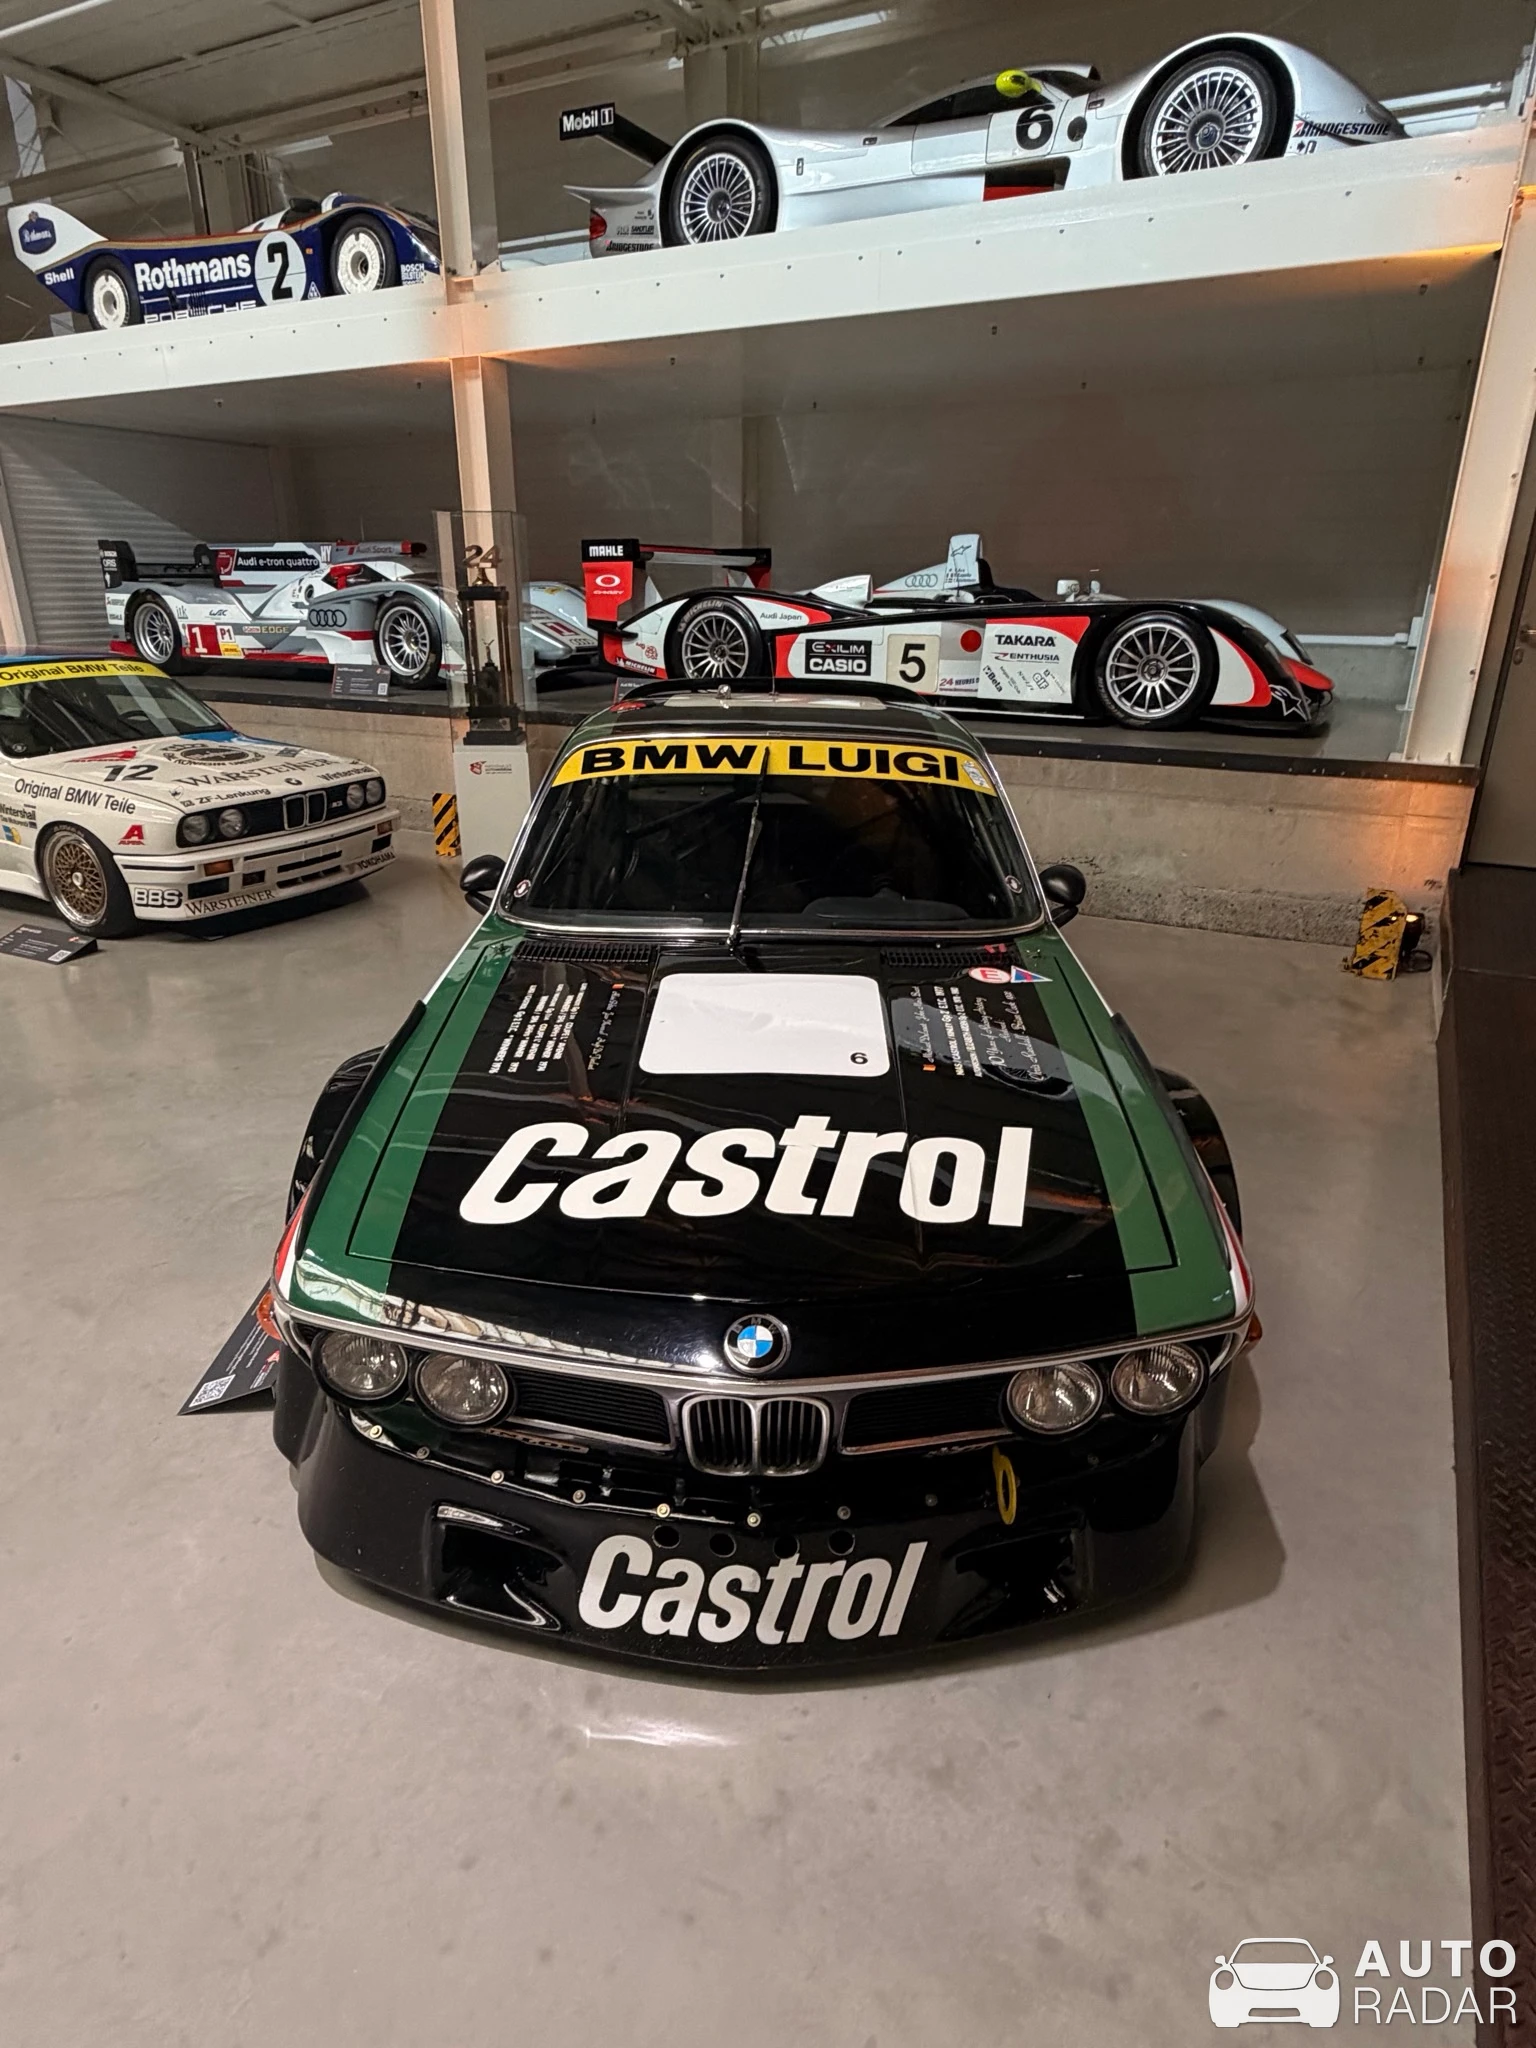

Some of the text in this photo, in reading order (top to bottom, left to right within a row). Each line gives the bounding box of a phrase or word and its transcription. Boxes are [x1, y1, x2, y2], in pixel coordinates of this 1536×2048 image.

[562, 110, 599, 133] Mobil
[1015, 104, 1055, 150] 6
[1293, 121, 1389, 137] BRIDGESTONE
[44, 267, 75, 285] Shell
[134, 253, 252, 292] Rothmans
[267, 241, 293, 300] 2
[401, 263, 424, 272] BOSCH
[321, 545, 332, 562] HY
[373, 545, 392, 554] Sport
[462, 545, 502, 568] 24
[589, 545, 624, 557] MAHLE
[237, 557, 319, 568] Audi e-tron quattro
[779, 612, 803, 621] Japan
[192, 626, 208, 654] 1
[219, 627, 233, 640] P1
[995, 635, 1055, 647] TAKARA
[812, 641, 865, 654] EXILIM
[809, 658, 867, 673] CASIO
[899, 643, 926, 683] 5
[1010, 653, 1060, 661] ENTHUSIA
[0, 663, 145, 680] Original BMW Teile
[625, 661, 656, 673] MICHELIN
[939, 678, 953, 687] 24
[988, 671, 1003, 692] Beta
[580, 745, 959, 780] BMW LUIGI
[103, 764, 158, 782] 12
[171, 758, 337, 787] WARSTEINER
[14, 778, 136, 814] Original BMW Teile
[195, 788, 271, 804] ZF-Lenkung
[357, 852, 396, 870] YOKOHAMA
[134, 887, 183, 908] BBS
[185, 889, 276, 915] WARSTEINER
[850, 1052, 868, 1065] 6
[458, 1114, 1033, 1228] Castrol
[577, 1534, 929, 1646] Castrol
